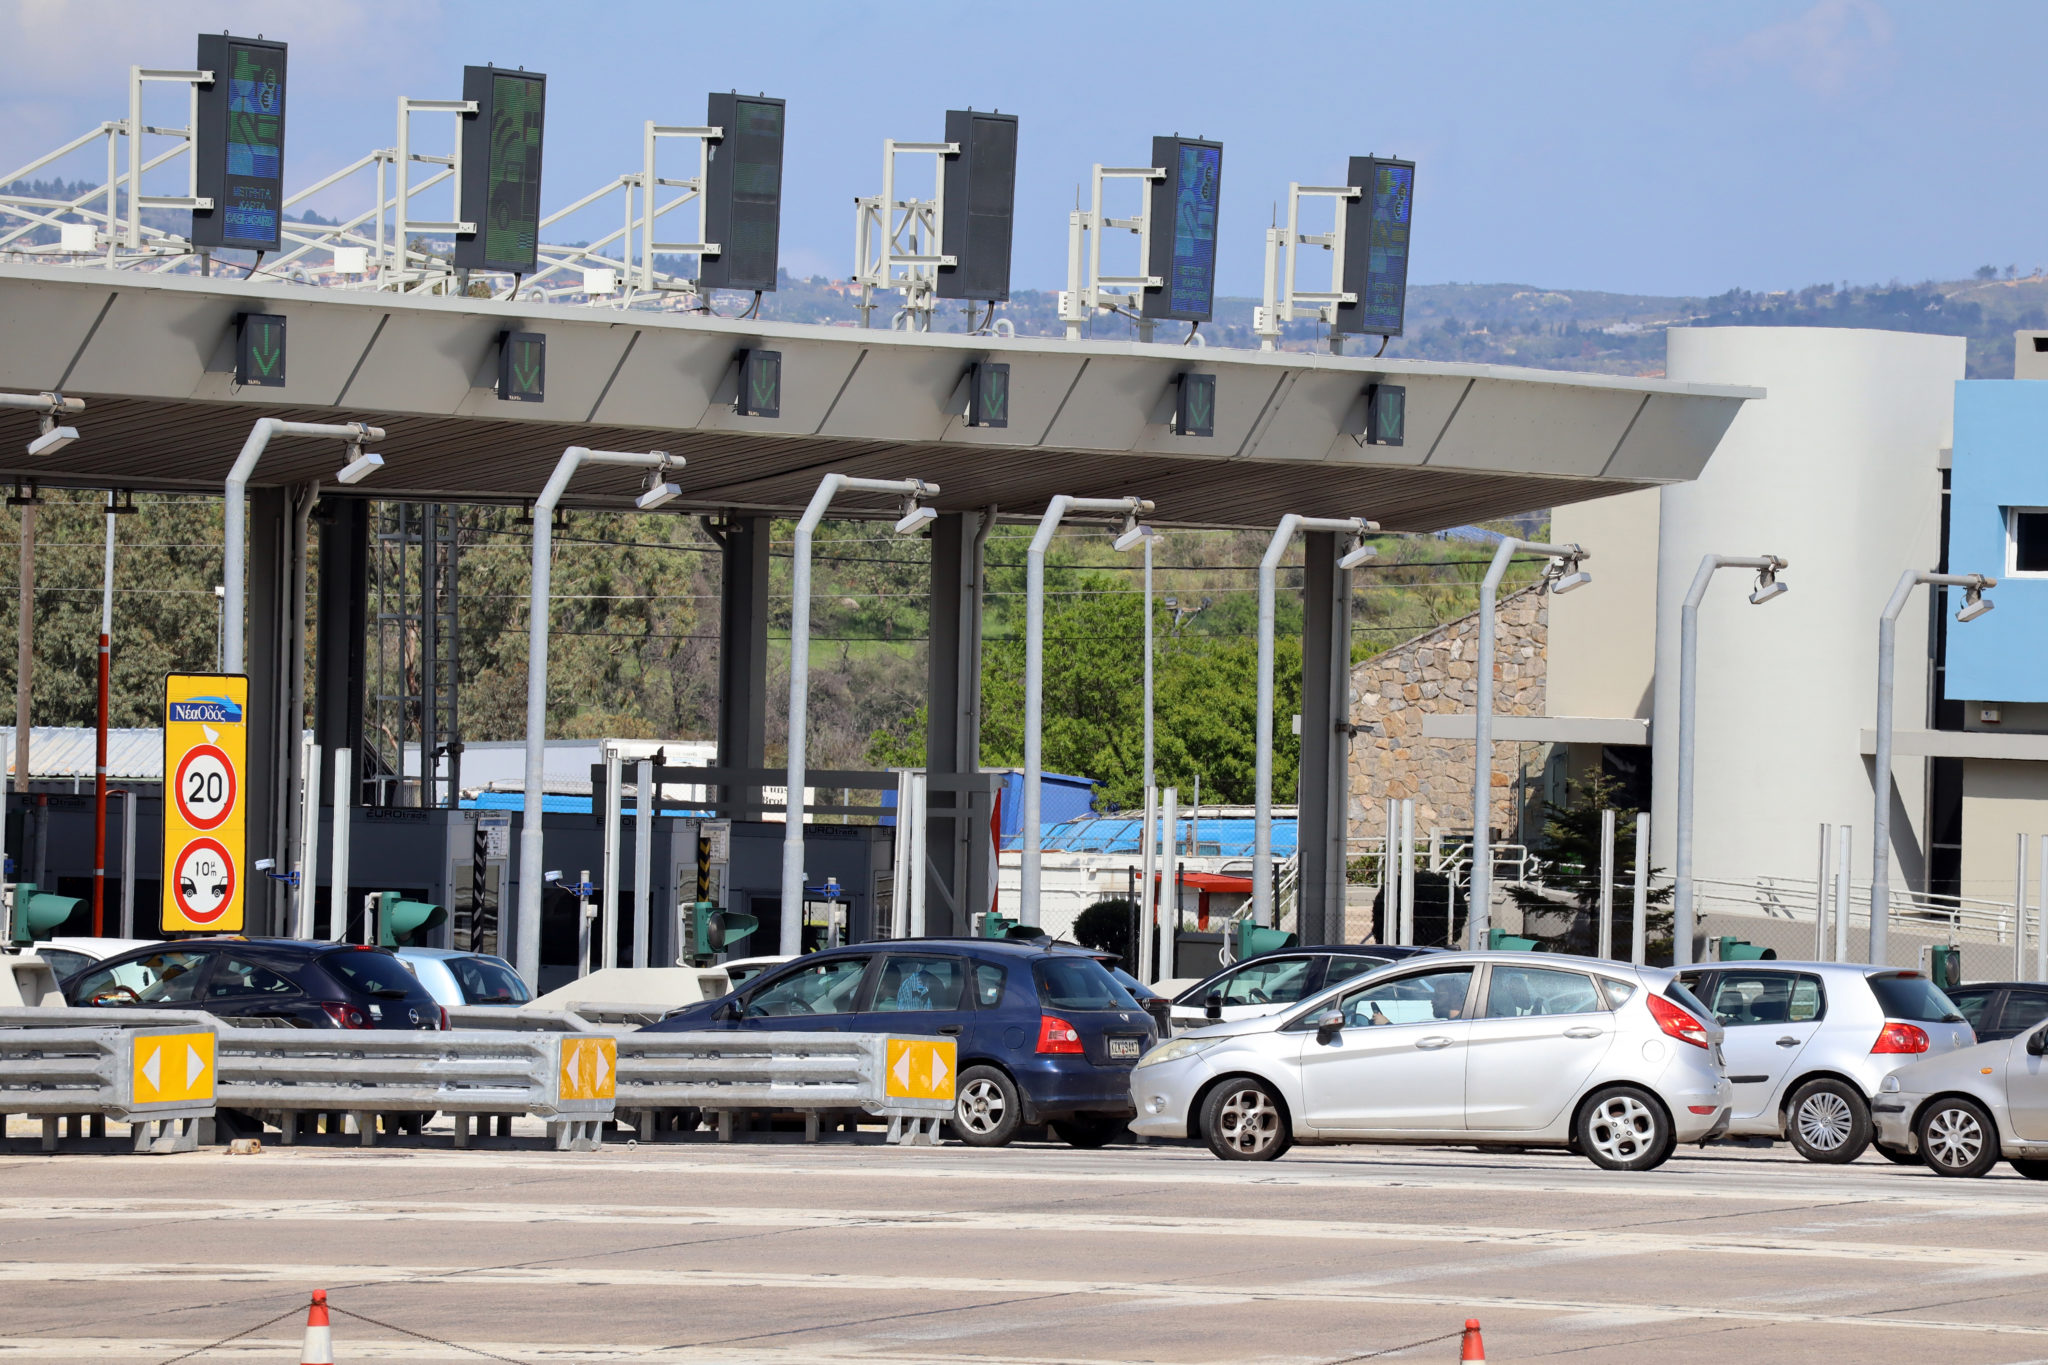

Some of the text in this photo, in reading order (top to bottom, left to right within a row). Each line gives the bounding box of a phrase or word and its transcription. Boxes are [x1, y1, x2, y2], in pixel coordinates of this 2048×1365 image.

[189, 771, 222, 803] 20
[22, 796, 87, 807] EUOtrade
[366, 808, 428, 819] EUROtrade
[195, 861, 209, 876] 10
